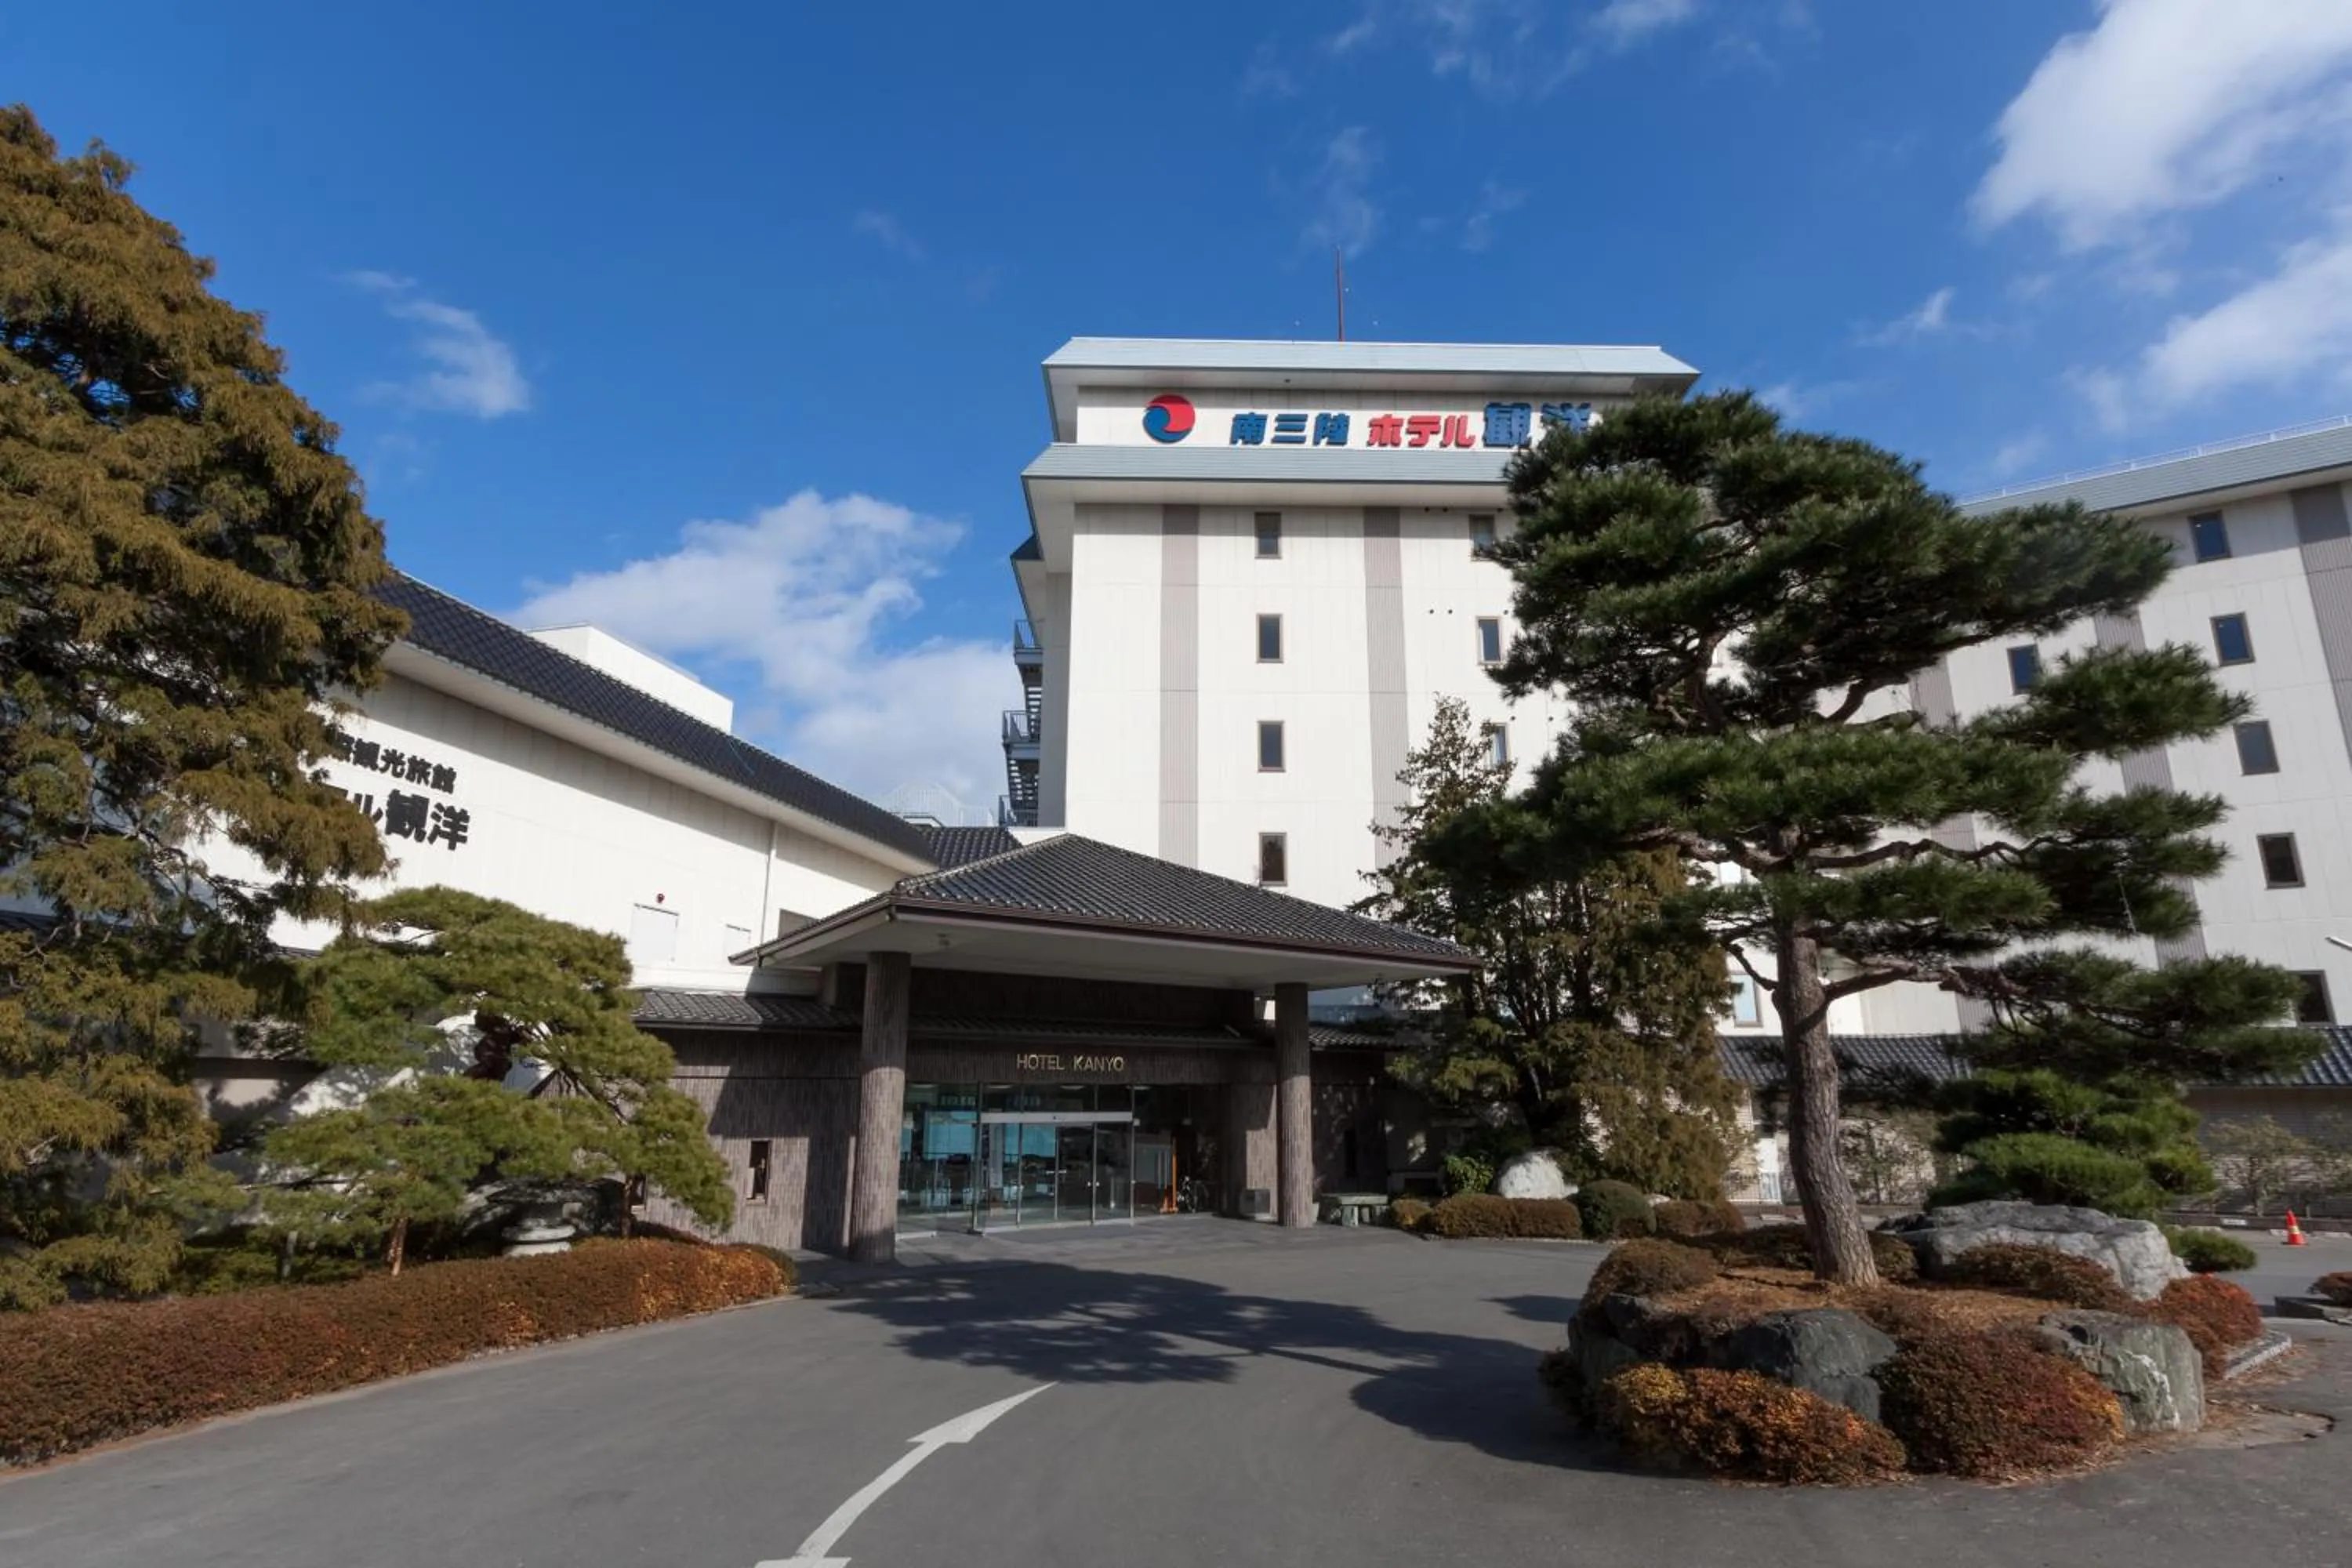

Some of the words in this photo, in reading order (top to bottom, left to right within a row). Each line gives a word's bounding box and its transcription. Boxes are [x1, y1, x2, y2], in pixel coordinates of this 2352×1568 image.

[1230, 412, 1350, 445] 南三陸
[1017, 1054, 1065, 1070] HOTEL
[1073, 1055, 1124, 1072] KANYO
